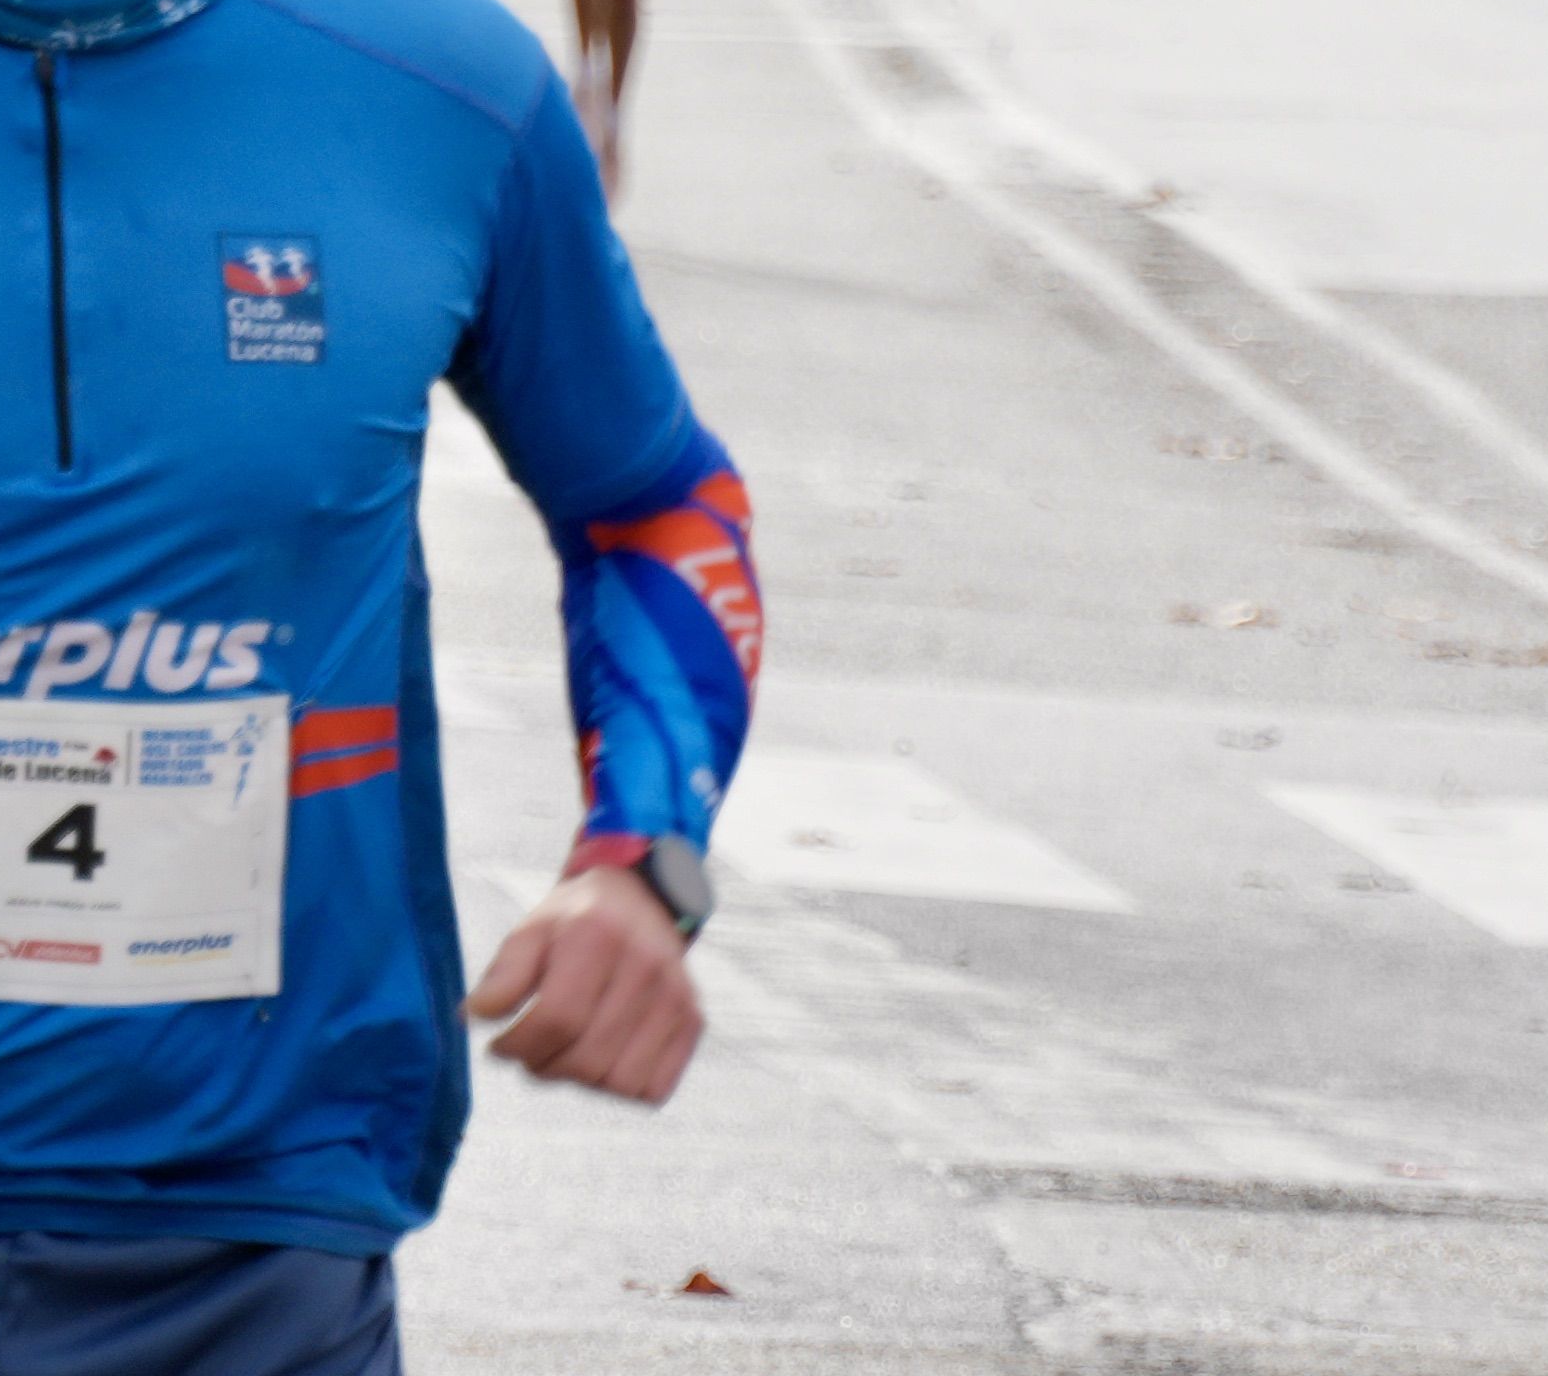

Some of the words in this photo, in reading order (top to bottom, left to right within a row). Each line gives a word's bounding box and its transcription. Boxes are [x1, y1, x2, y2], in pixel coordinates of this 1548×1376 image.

[227, 297, 284, 320] Club
[229, 340, 318, 361] Lucena
[25, 761, 113, 786] Lucena
[26, 802, 107, 882] 4
[127, 933, 233, 957] enerplus
